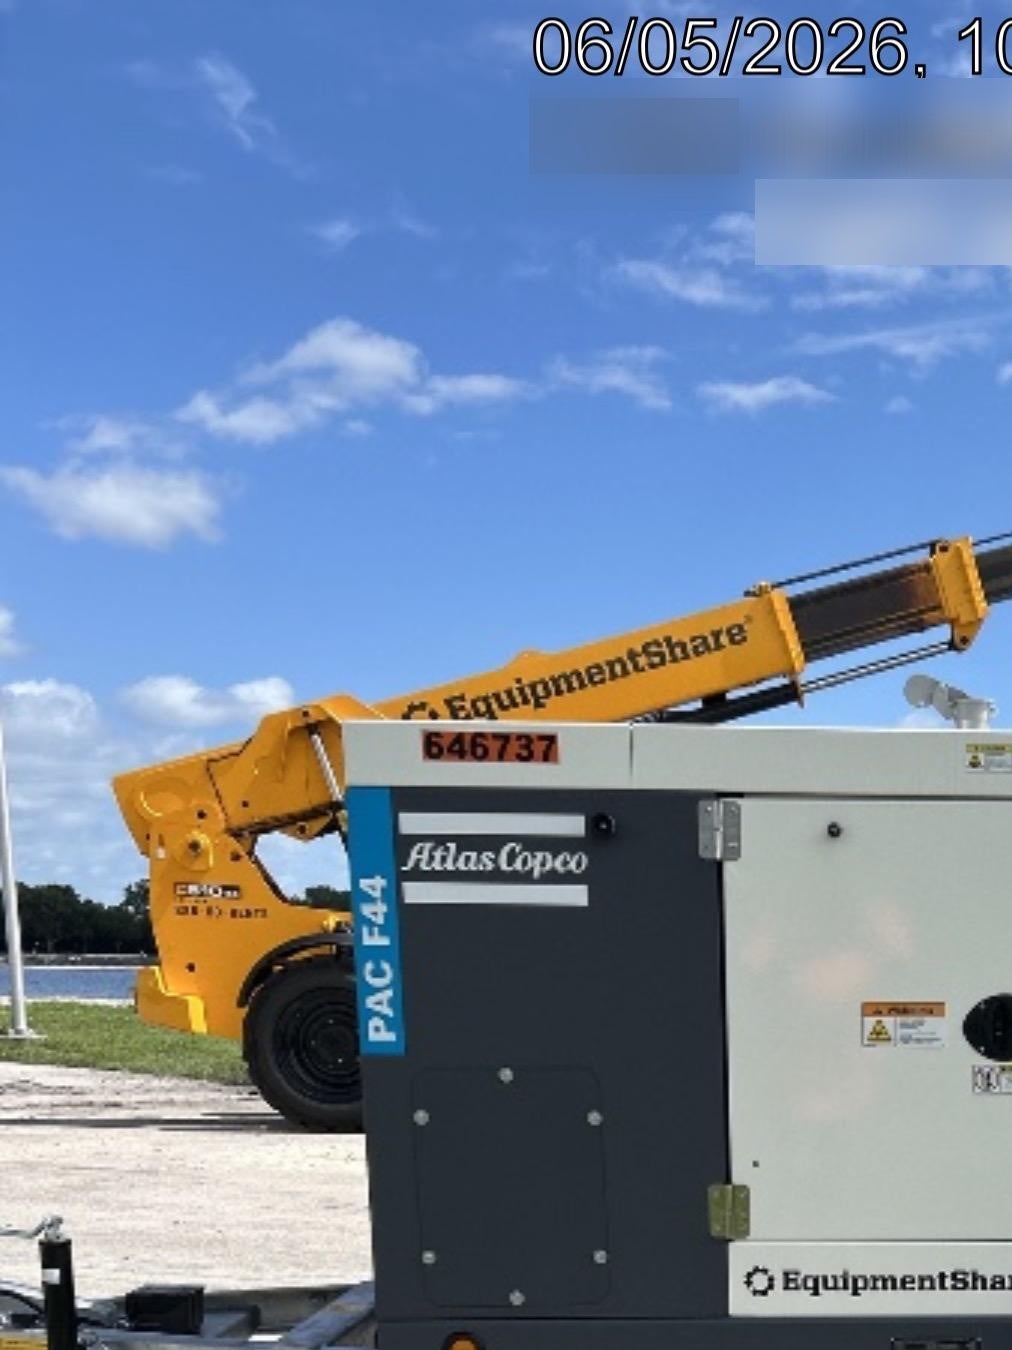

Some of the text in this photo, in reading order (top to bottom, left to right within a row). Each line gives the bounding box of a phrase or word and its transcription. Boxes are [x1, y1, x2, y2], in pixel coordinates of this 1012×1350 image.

[442, 622, 749, 721] EquipmentShare
[423, 732, 557, 763] 646737
[401, 842, 589, 880] Atlas Copco
[359, 875, 397, 1043] PAC F44
